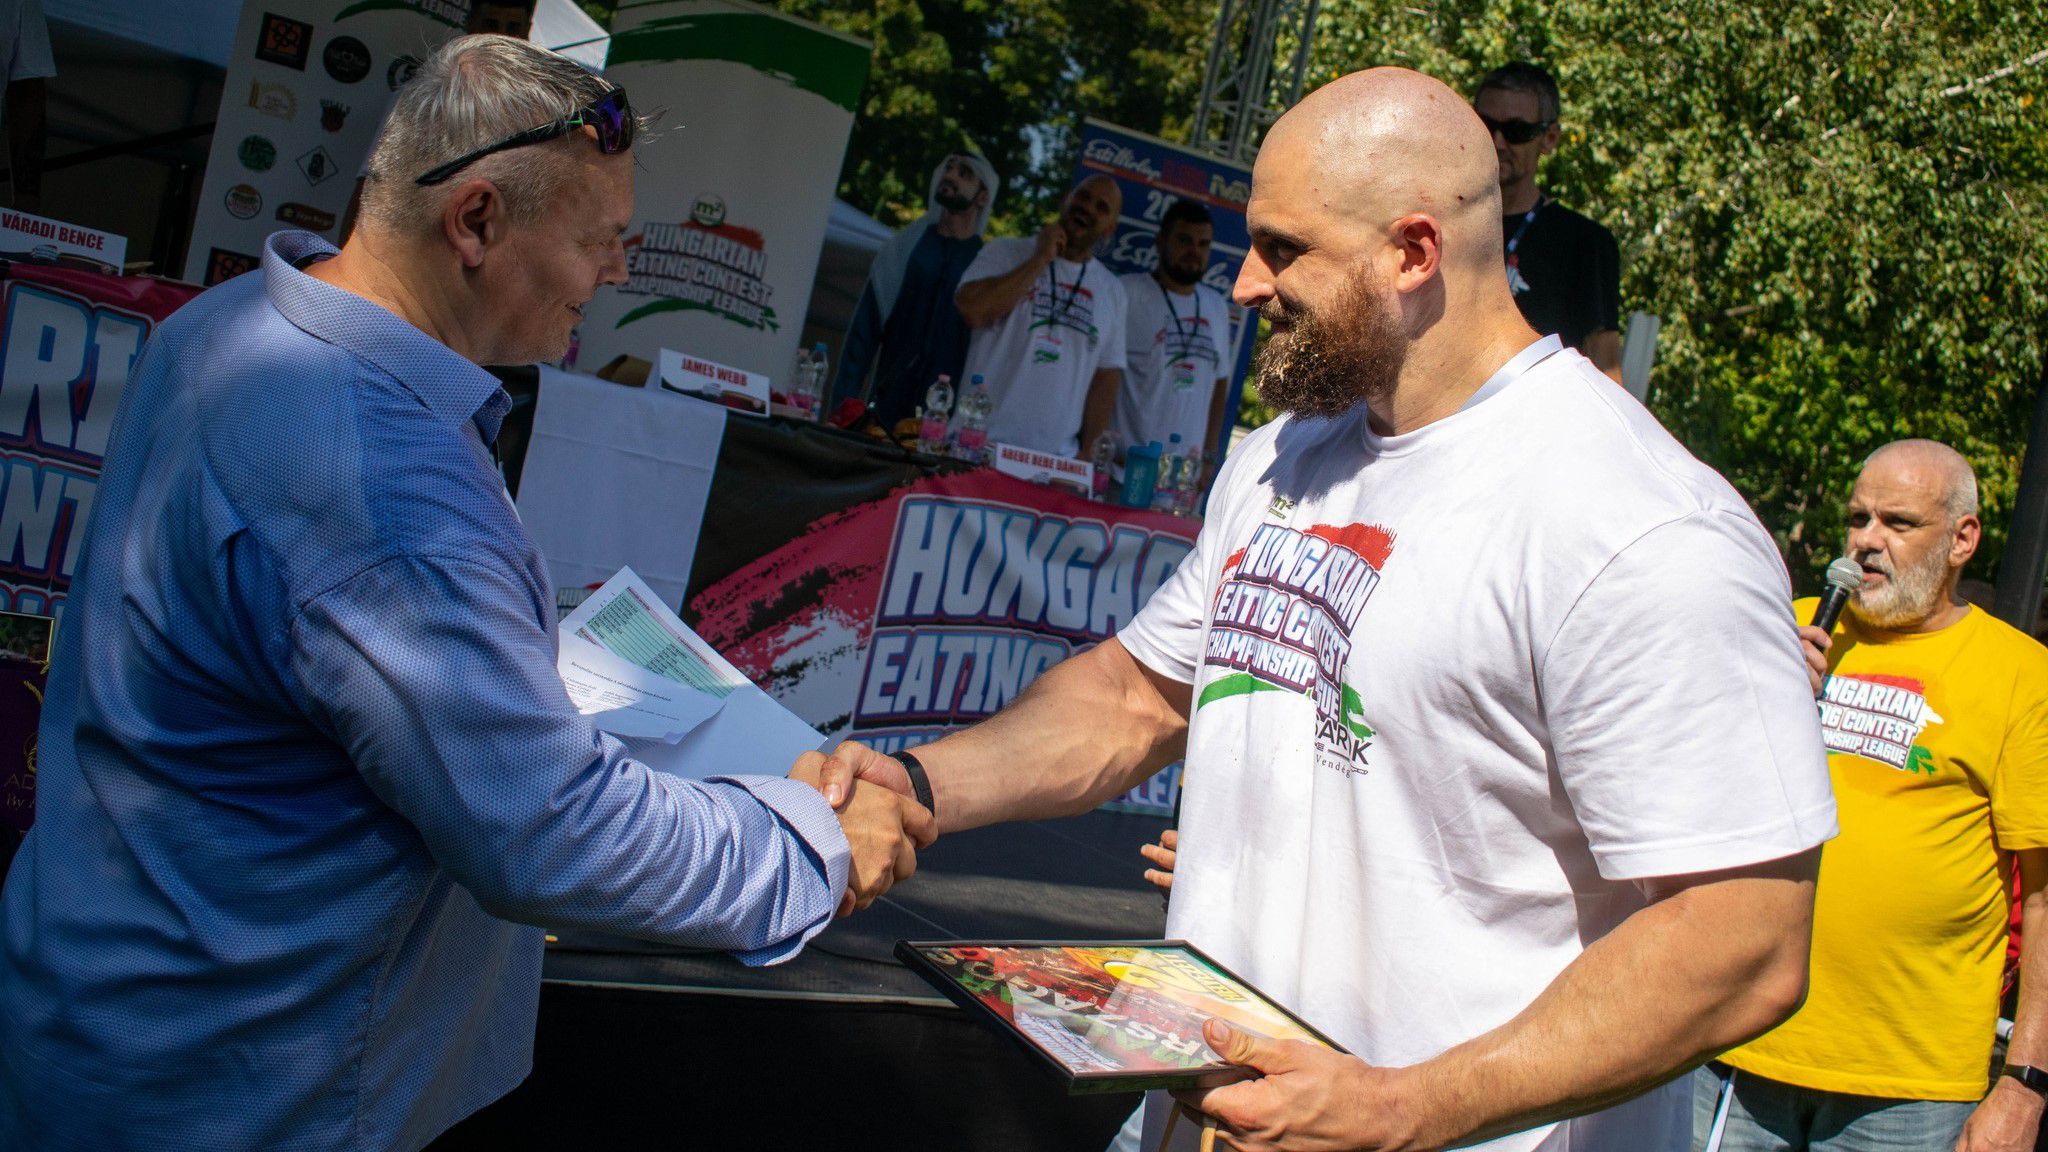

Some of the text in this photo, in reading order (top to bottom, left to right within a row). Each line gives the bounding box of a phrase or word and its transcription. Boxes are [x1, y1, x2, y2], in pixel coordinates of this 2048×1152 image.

[2, 212, 105, 250] VÁRADI BENCE
[642, 223, 768, 281] HUNGARIAN
[628, 246, 774, 307] EATING CONTEST
[712, 290, 767, 330] LEAGUE
[682, 358, 749, 387] JAMES WEBB
[1824, 675, 1923, 724] NGARIAN
[1843, 708, 1918, 747] CONTEST
[1861, 737, 1908, 766] LEAGUE
[4, 772, 36, 790] AD
